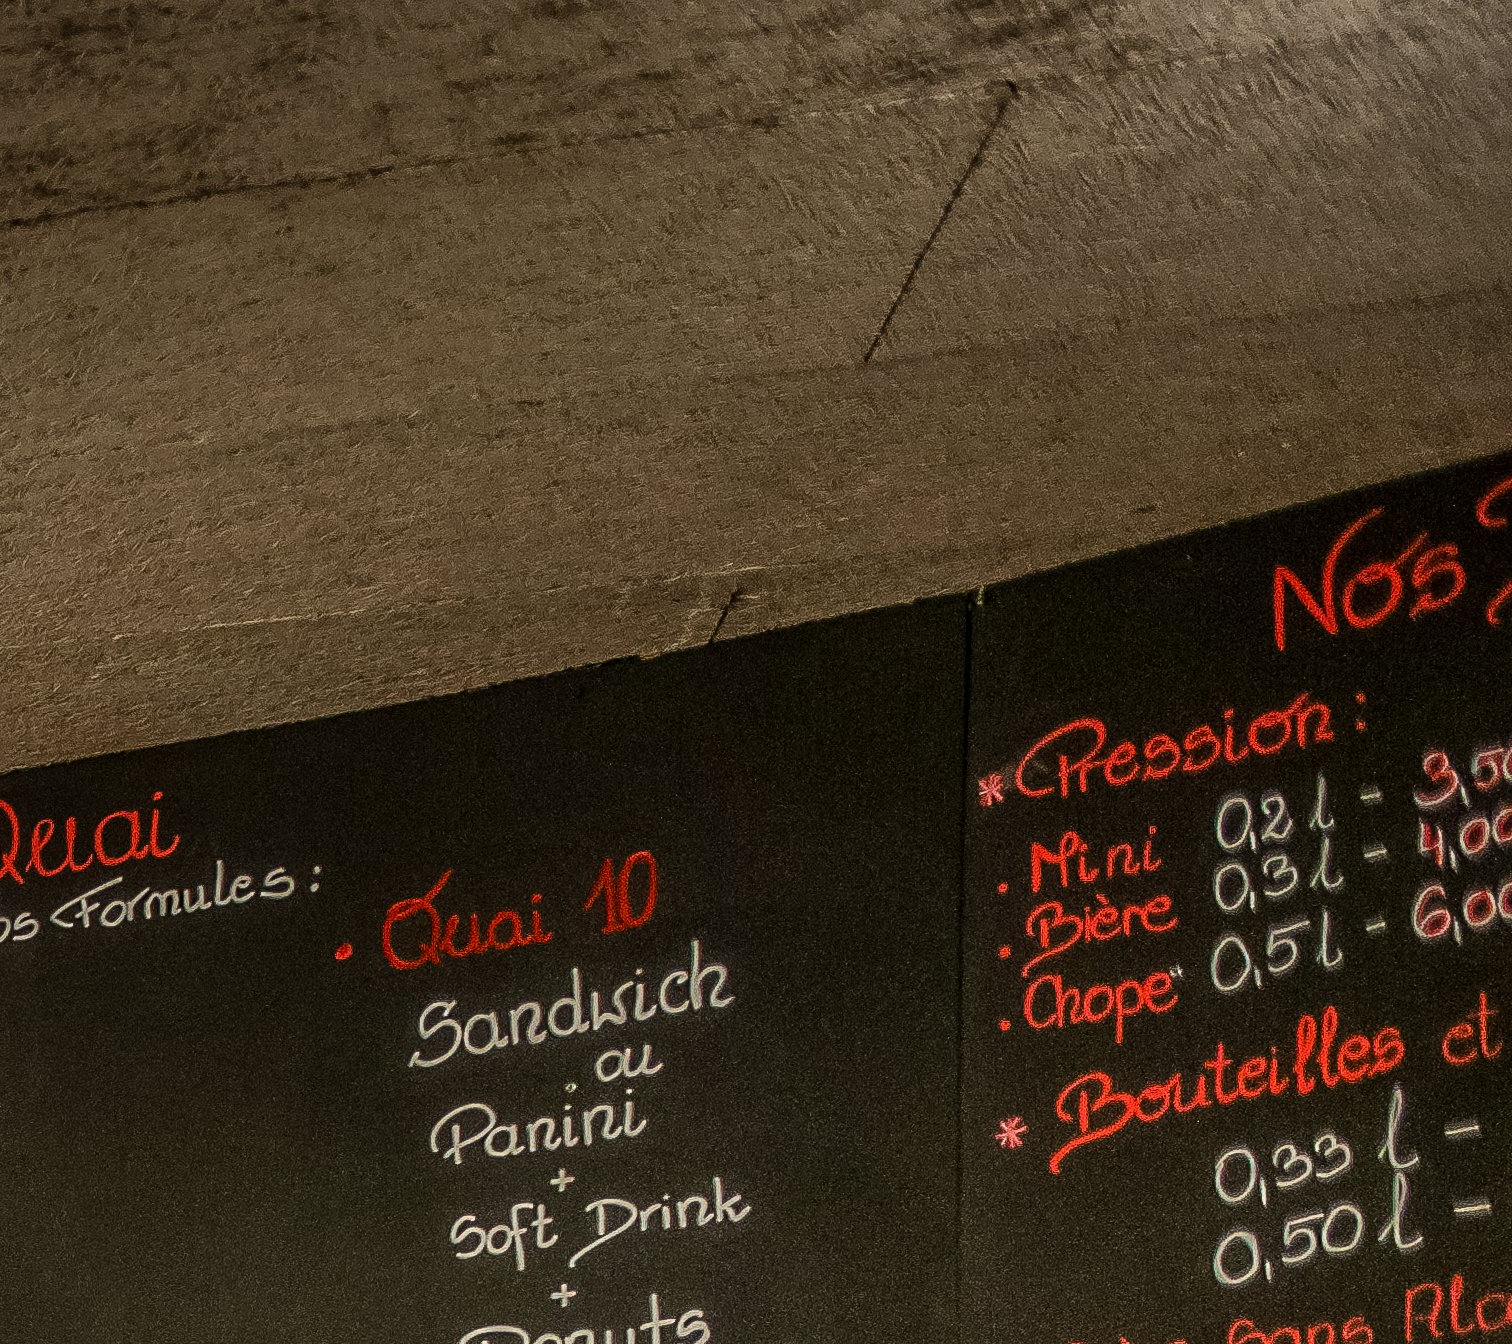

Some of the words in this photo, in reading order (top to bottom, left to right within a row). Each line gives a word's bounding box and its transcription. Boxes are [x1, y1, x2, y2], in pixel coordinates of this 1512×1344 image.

[1272, 508, 1467, 652] Nos
[1030, 825, 1162, 894] Mini
[381, 870, 553, 971] Quai
[584, 850, 658, 934] 10
[1020, 892, 1179, 979] Bière
[407, 939, 736, 1068] Sandwich
[1022, 970, 1179, 1045] Chope
[593, 1043, 664, 1083] ou
[1048, 1005, 1406, 1175] Bouteilles
[1441, 991, 1501, 1066] et
[429, 1087, 648, 1166] Panini
[1214, 1132, 1353, 1209] 0,33
[449, 1201, 559, 1272] Soft
[567, 1176, 753, 1269] Drink
[1212, 1200, 1365, 1288] 0,50
